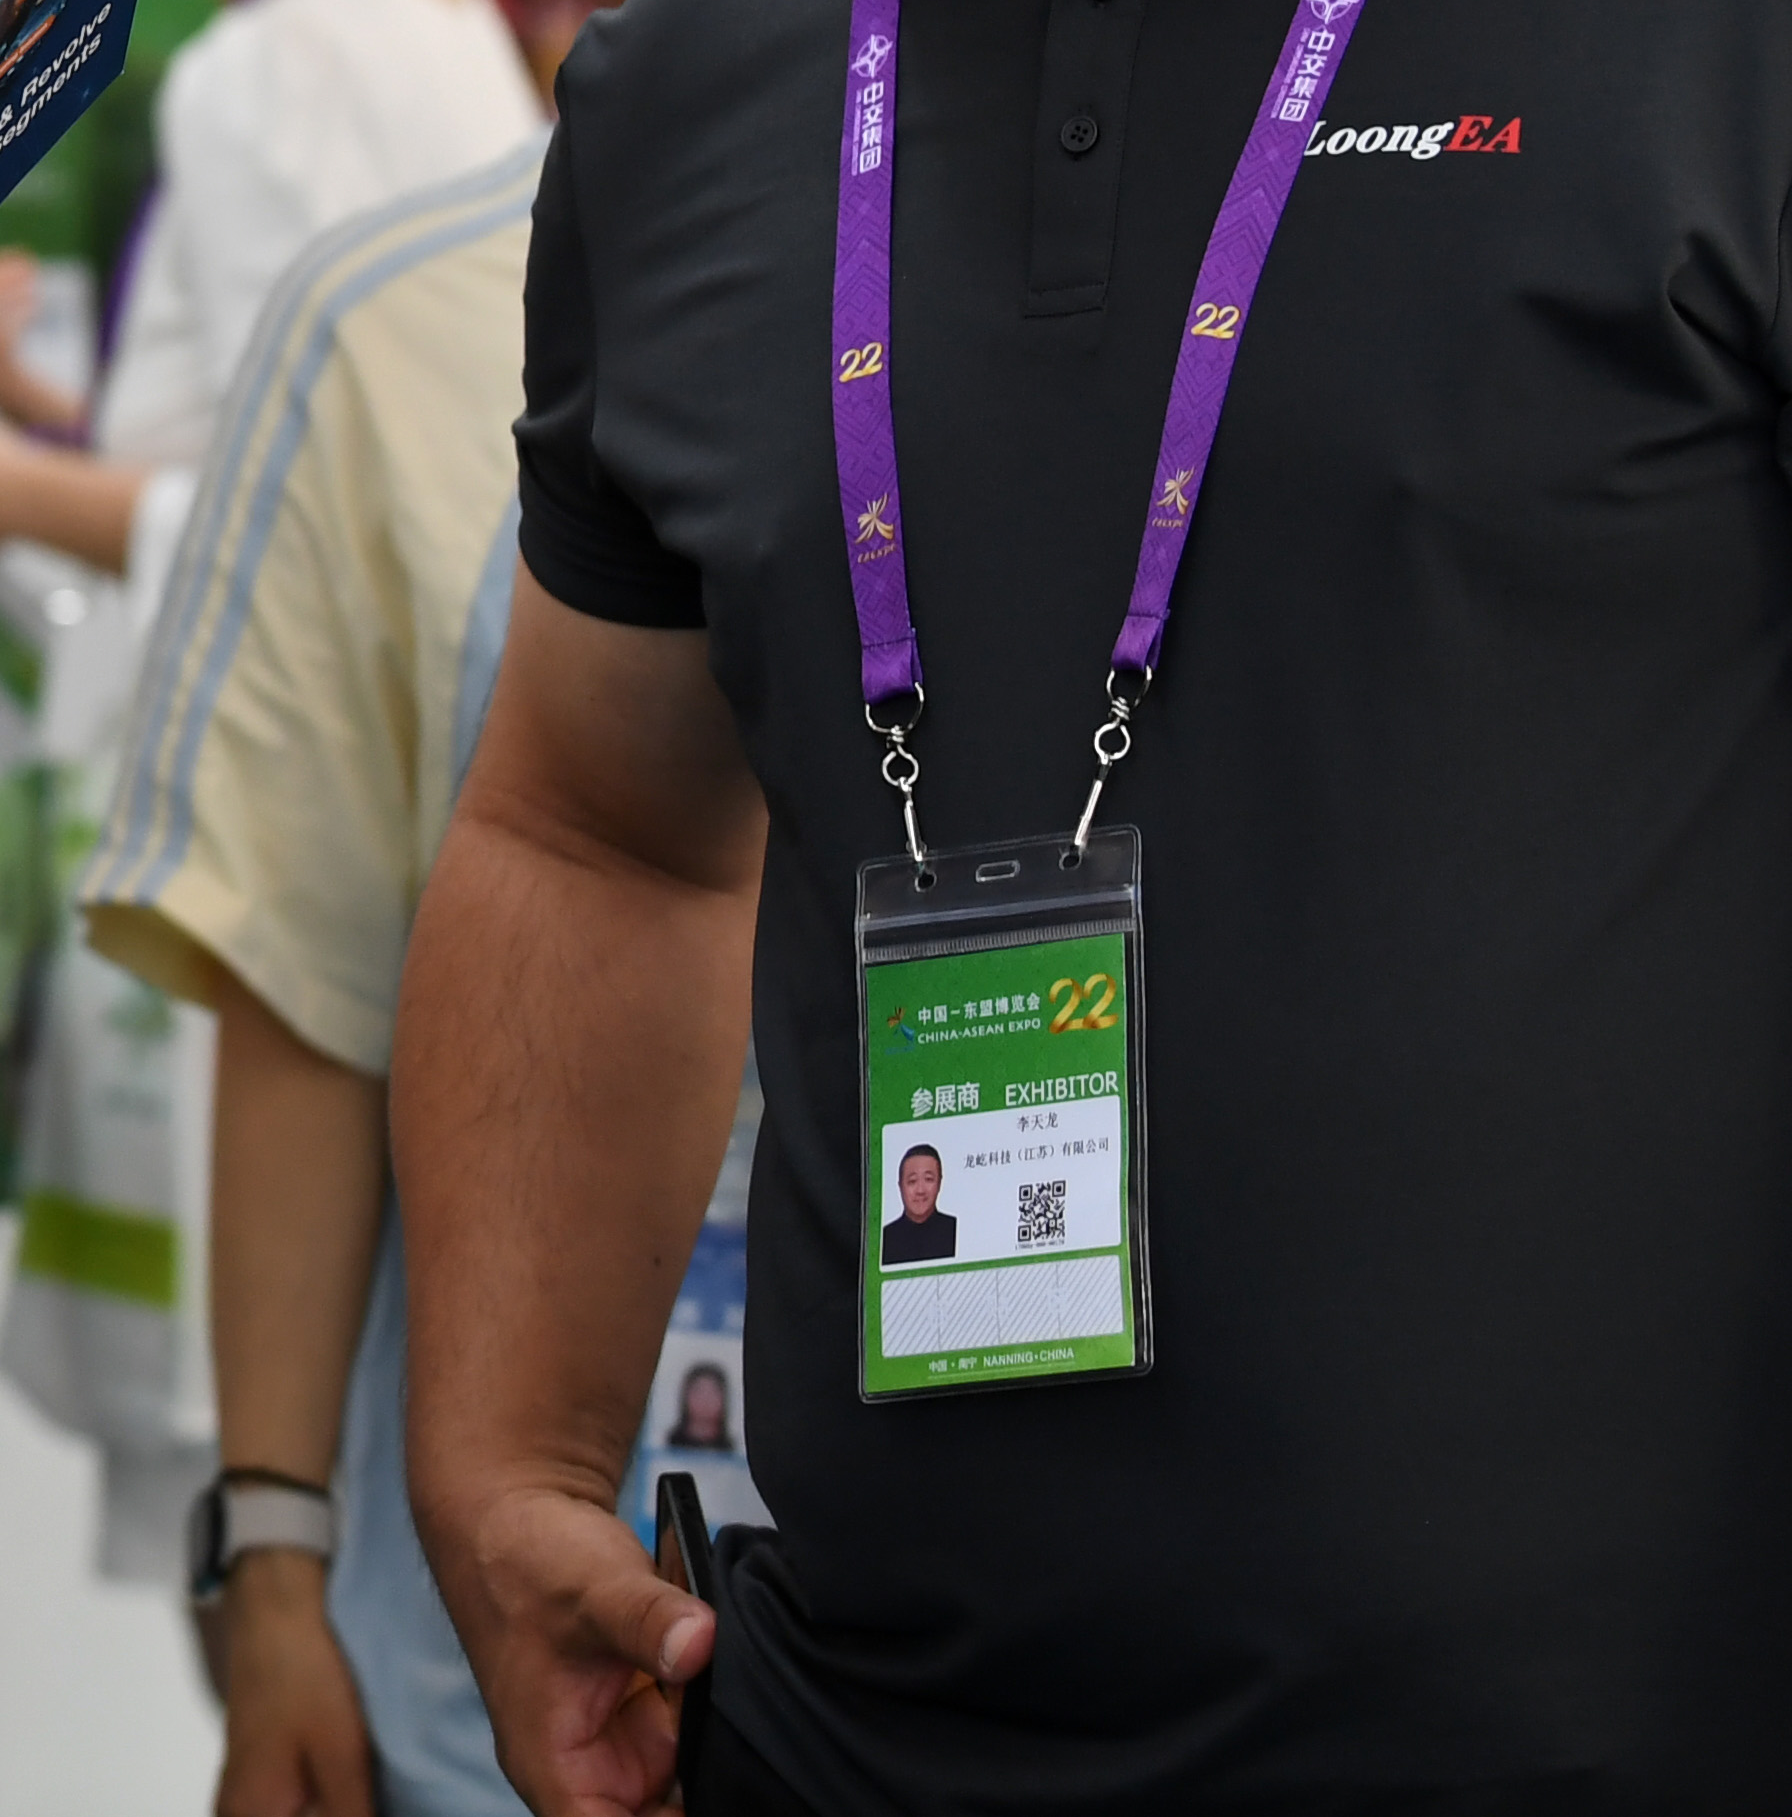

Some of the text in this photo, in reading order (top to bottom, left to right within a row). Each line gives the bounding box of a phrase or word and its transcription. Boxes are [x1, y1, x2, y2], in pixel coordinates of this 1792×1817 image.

[20, 2, 112, 108] Revolve
[1278, 26, 1336, 123] 中交集团
[857, 81, 884, 175] 中交集团
[1303, 114, 1522, 160] LoongEA
[1189, 301, 1240, 340] 22
[839, 341, 884, 383] 22
[1048, 972, 1119, 1034] 22
[917, 1017, 1042, 1045] CHINA-ASEAN EXPO
[910, 1069, 1120, 1118] 参展商 EXHIBITOR
